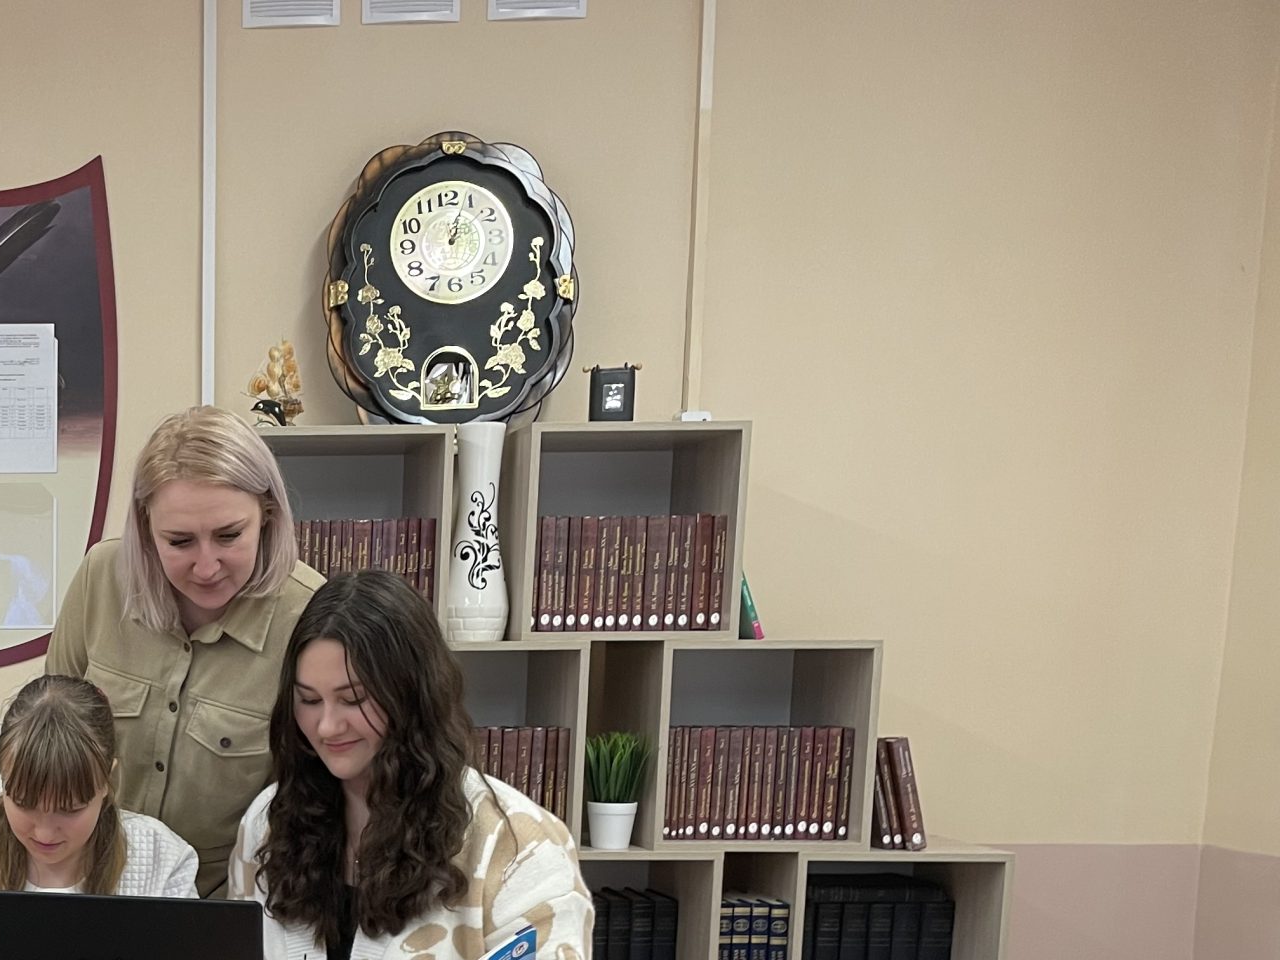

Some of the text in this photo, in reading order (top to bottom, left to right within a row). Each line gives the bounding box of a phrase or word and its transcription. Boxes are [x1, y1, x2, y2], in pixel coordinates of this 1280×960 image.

[437, 190, 458, 207] 12
[468, 194, 473, 208] 1
[417, 199, 432, 214] 11
[480, 208, 496, 222] 2
[402, 218, 420, 234] 10
[488, 229, 504, 245] 3
[400, 240, 415, 255] 9
[483, 252, 498, 266] 4
[408, 261, 423, 277] 8
[425, 276, 440, 291] 7
[448, 277, 463, 292] 6
[471, 269, 486, 286] 5
